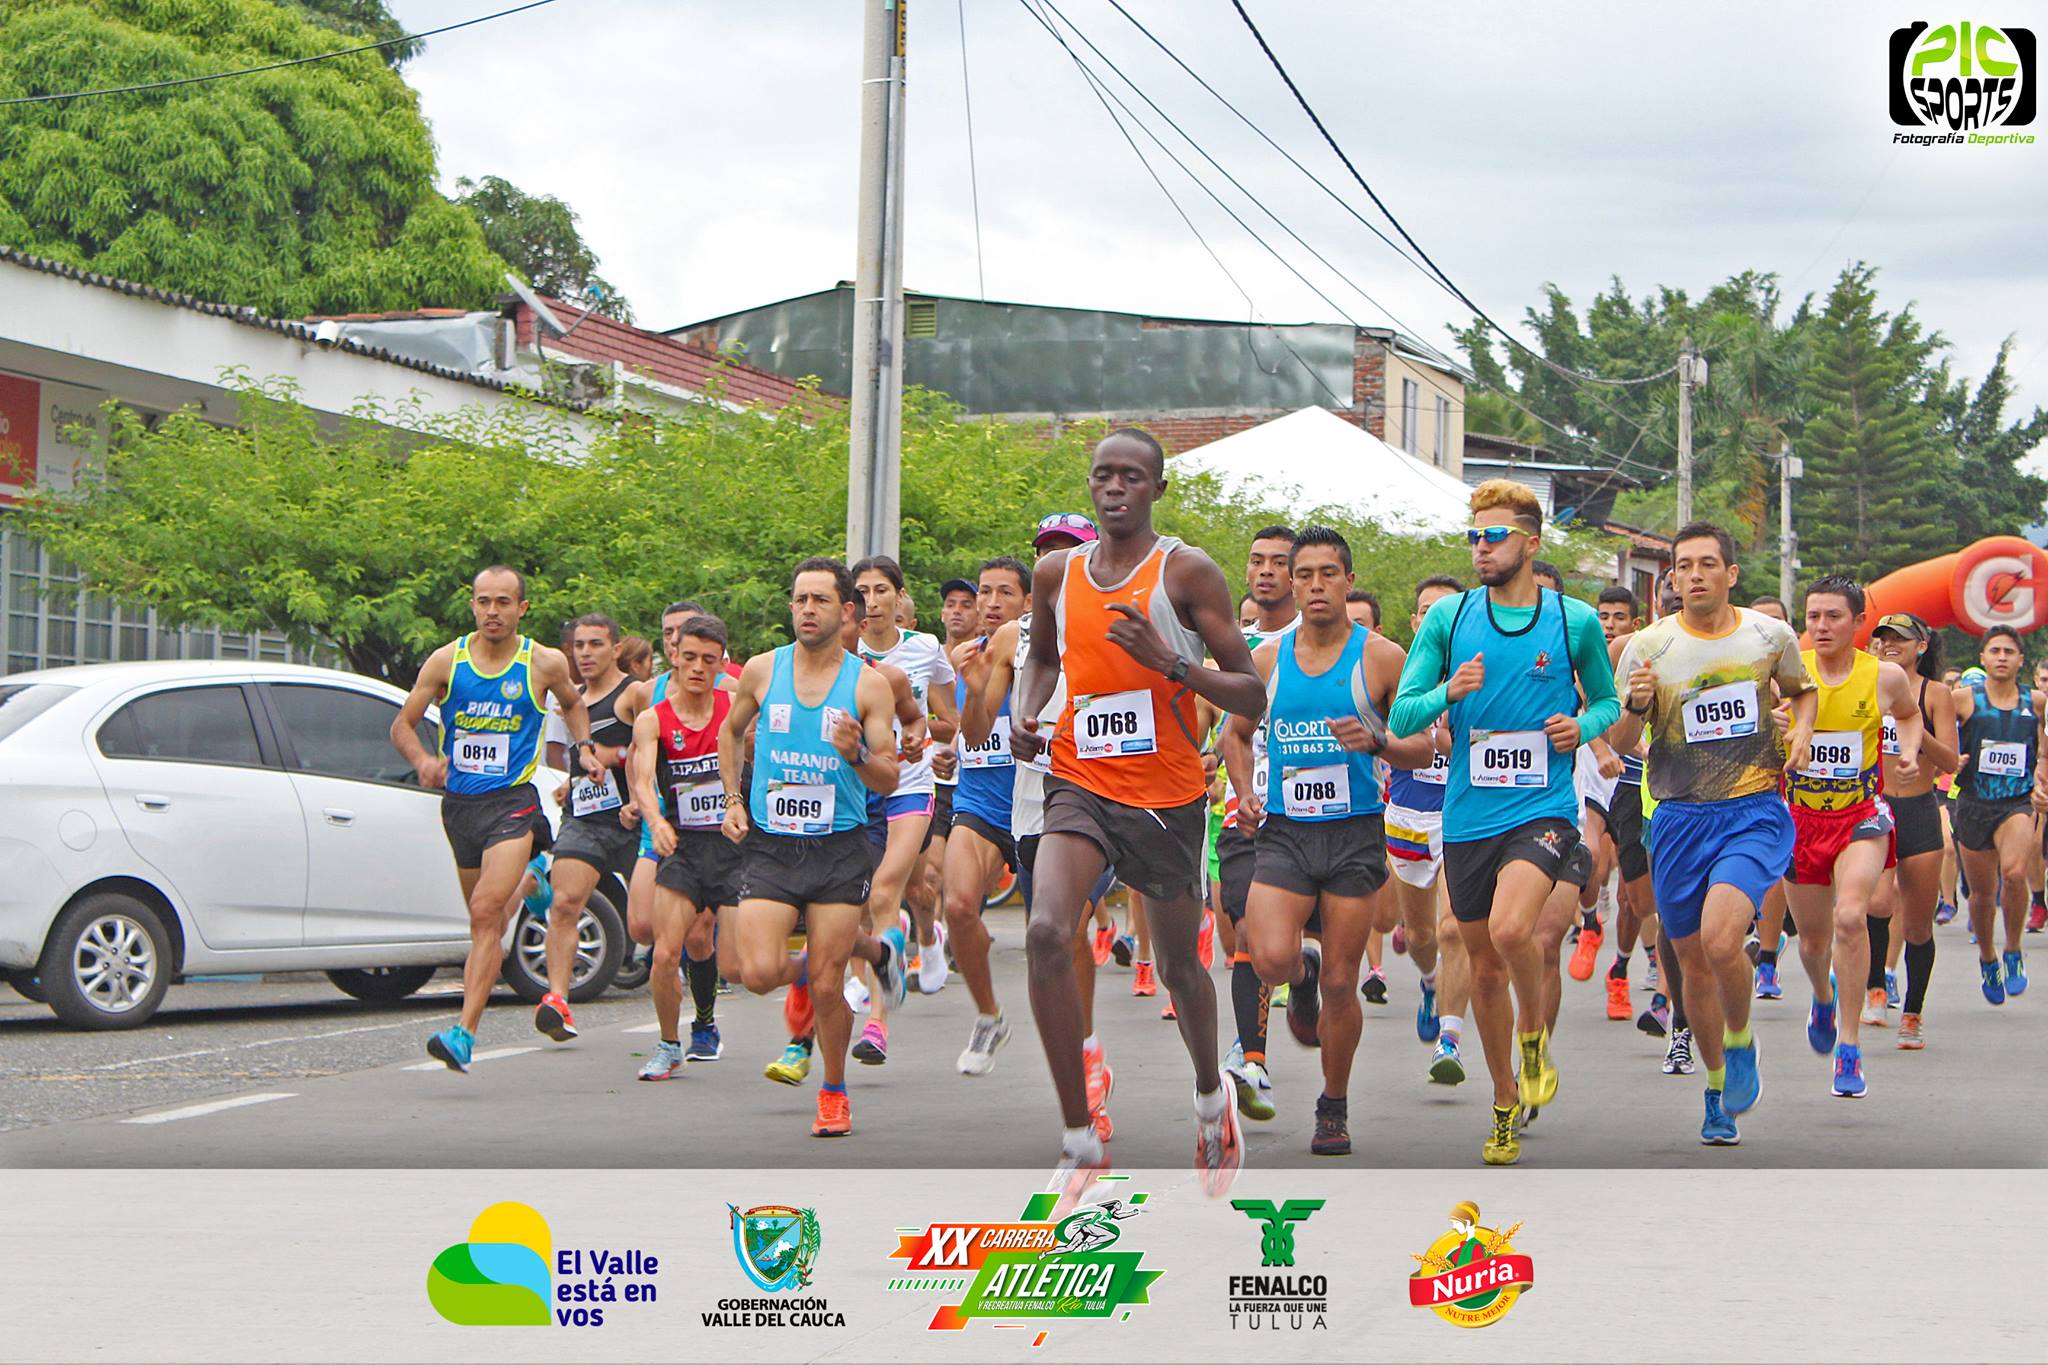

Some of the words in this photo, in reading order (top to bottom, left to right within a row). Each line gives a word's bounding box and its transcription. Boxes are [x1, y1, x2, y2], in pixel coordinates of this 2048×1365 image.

[466, 701, 513, 718] BIKILA
[1695, 699, 1746, 724] 0596
[1087, 711, 1138, 737] 0768
[463, 744, 497, 762] 0814
[1283, 744, 1300, 755] 310
[1303, 743, 1324, 753] 865
[1484, 748, 1531, 769] 0519
[770, 749, 840, 773] NARANJO
[1989, 752, 2017, 766] 0705
[782, 768, 825, 785] TEAM
[1294, 781, 1336, 801] 0788
[691, 794, 728, 813] 0673
[776, 797, 821, 819] 0669
